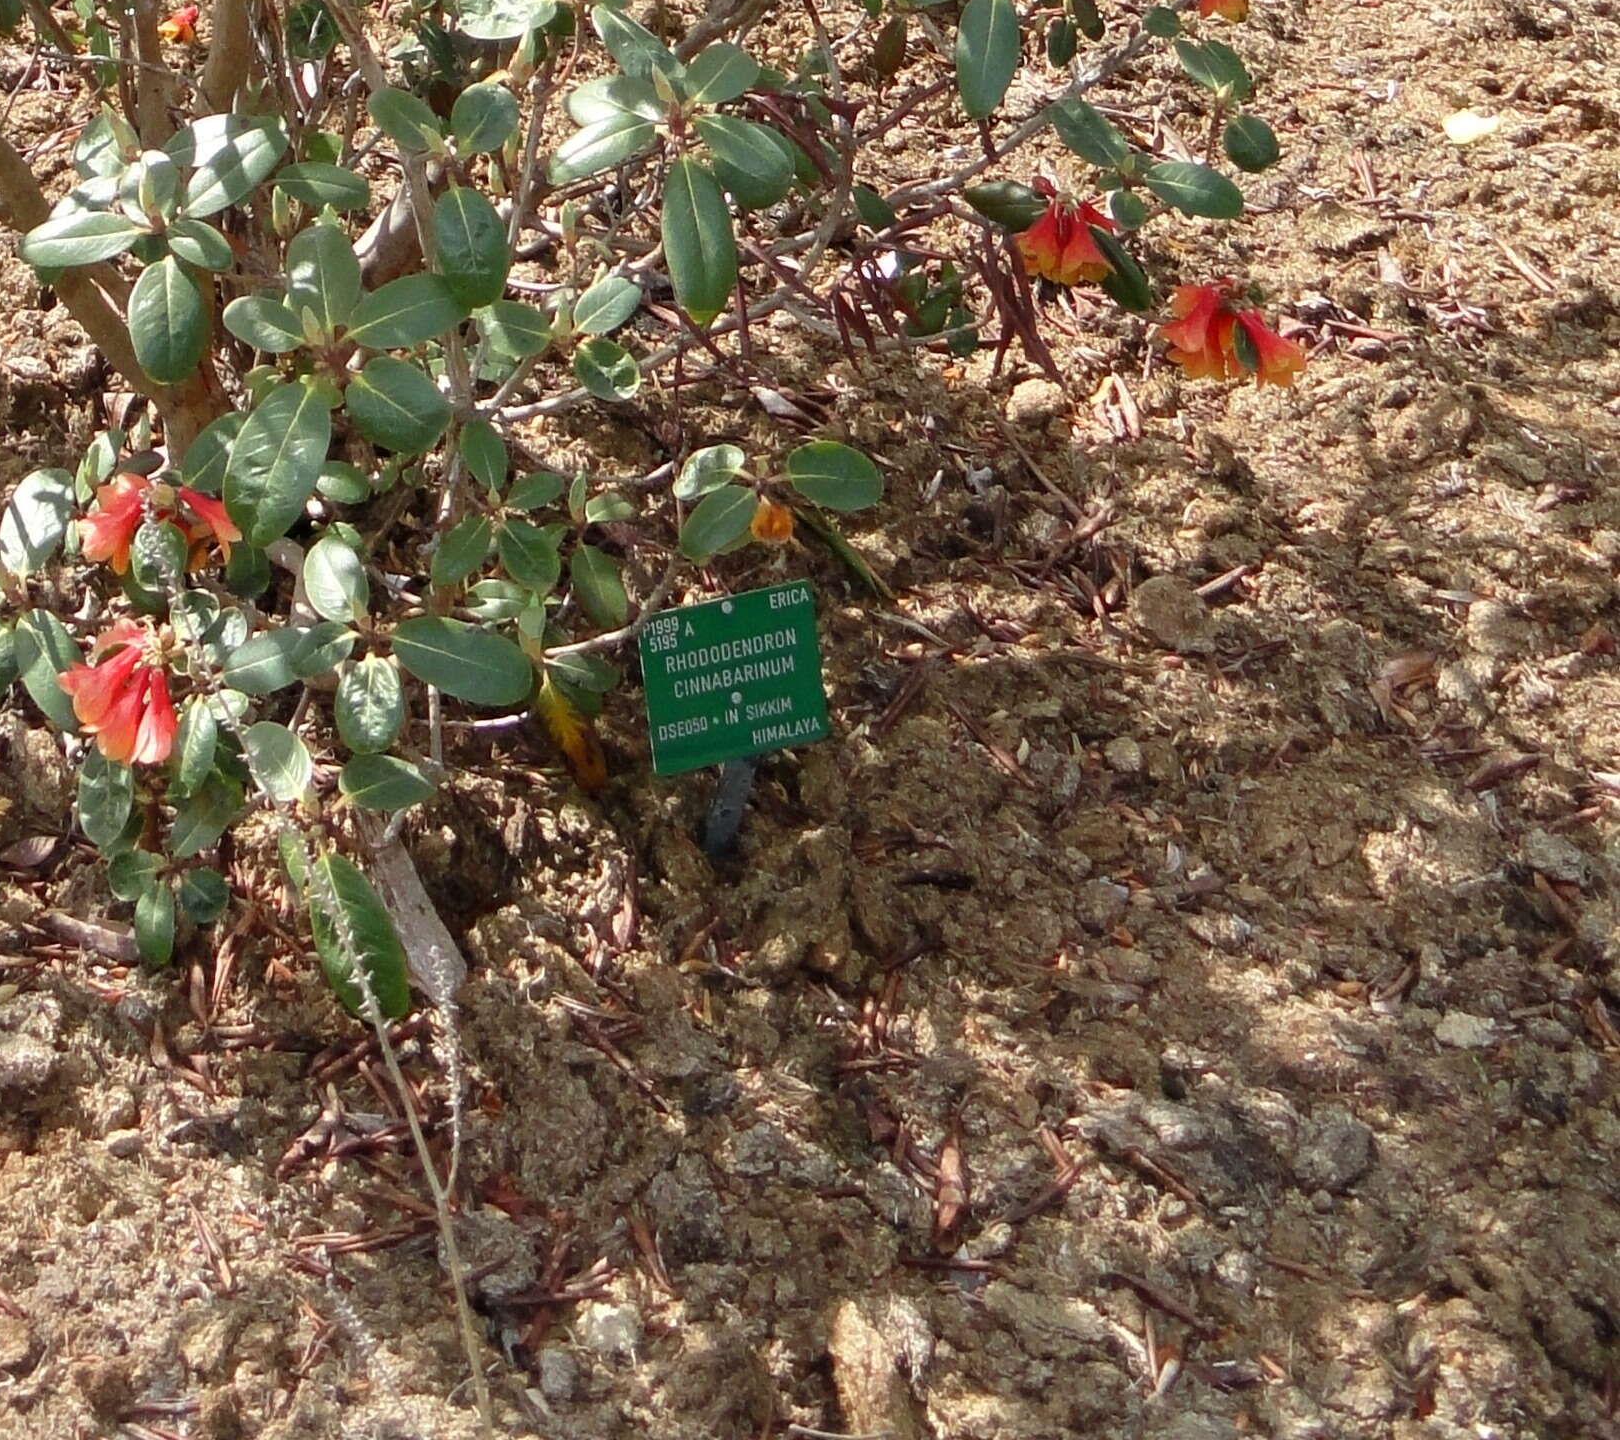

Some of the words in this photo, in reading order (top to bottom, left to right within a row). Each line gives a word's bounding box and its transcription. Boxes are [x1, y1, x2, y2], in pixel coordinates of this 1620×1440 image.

[769, 587, 810, 610] ERICA
[649, 633, 678, 653] 5195
[684, 621, 695, 637] A
[665, 628, 797, 674] RHODODENDRON
[673, 656, 795, 698] CINNABARINUM
[724, 708, 739, 726] IN
[745, 696, 793, 721] SIKKIM
[752, 716, 821, 745] HIMALAYA
